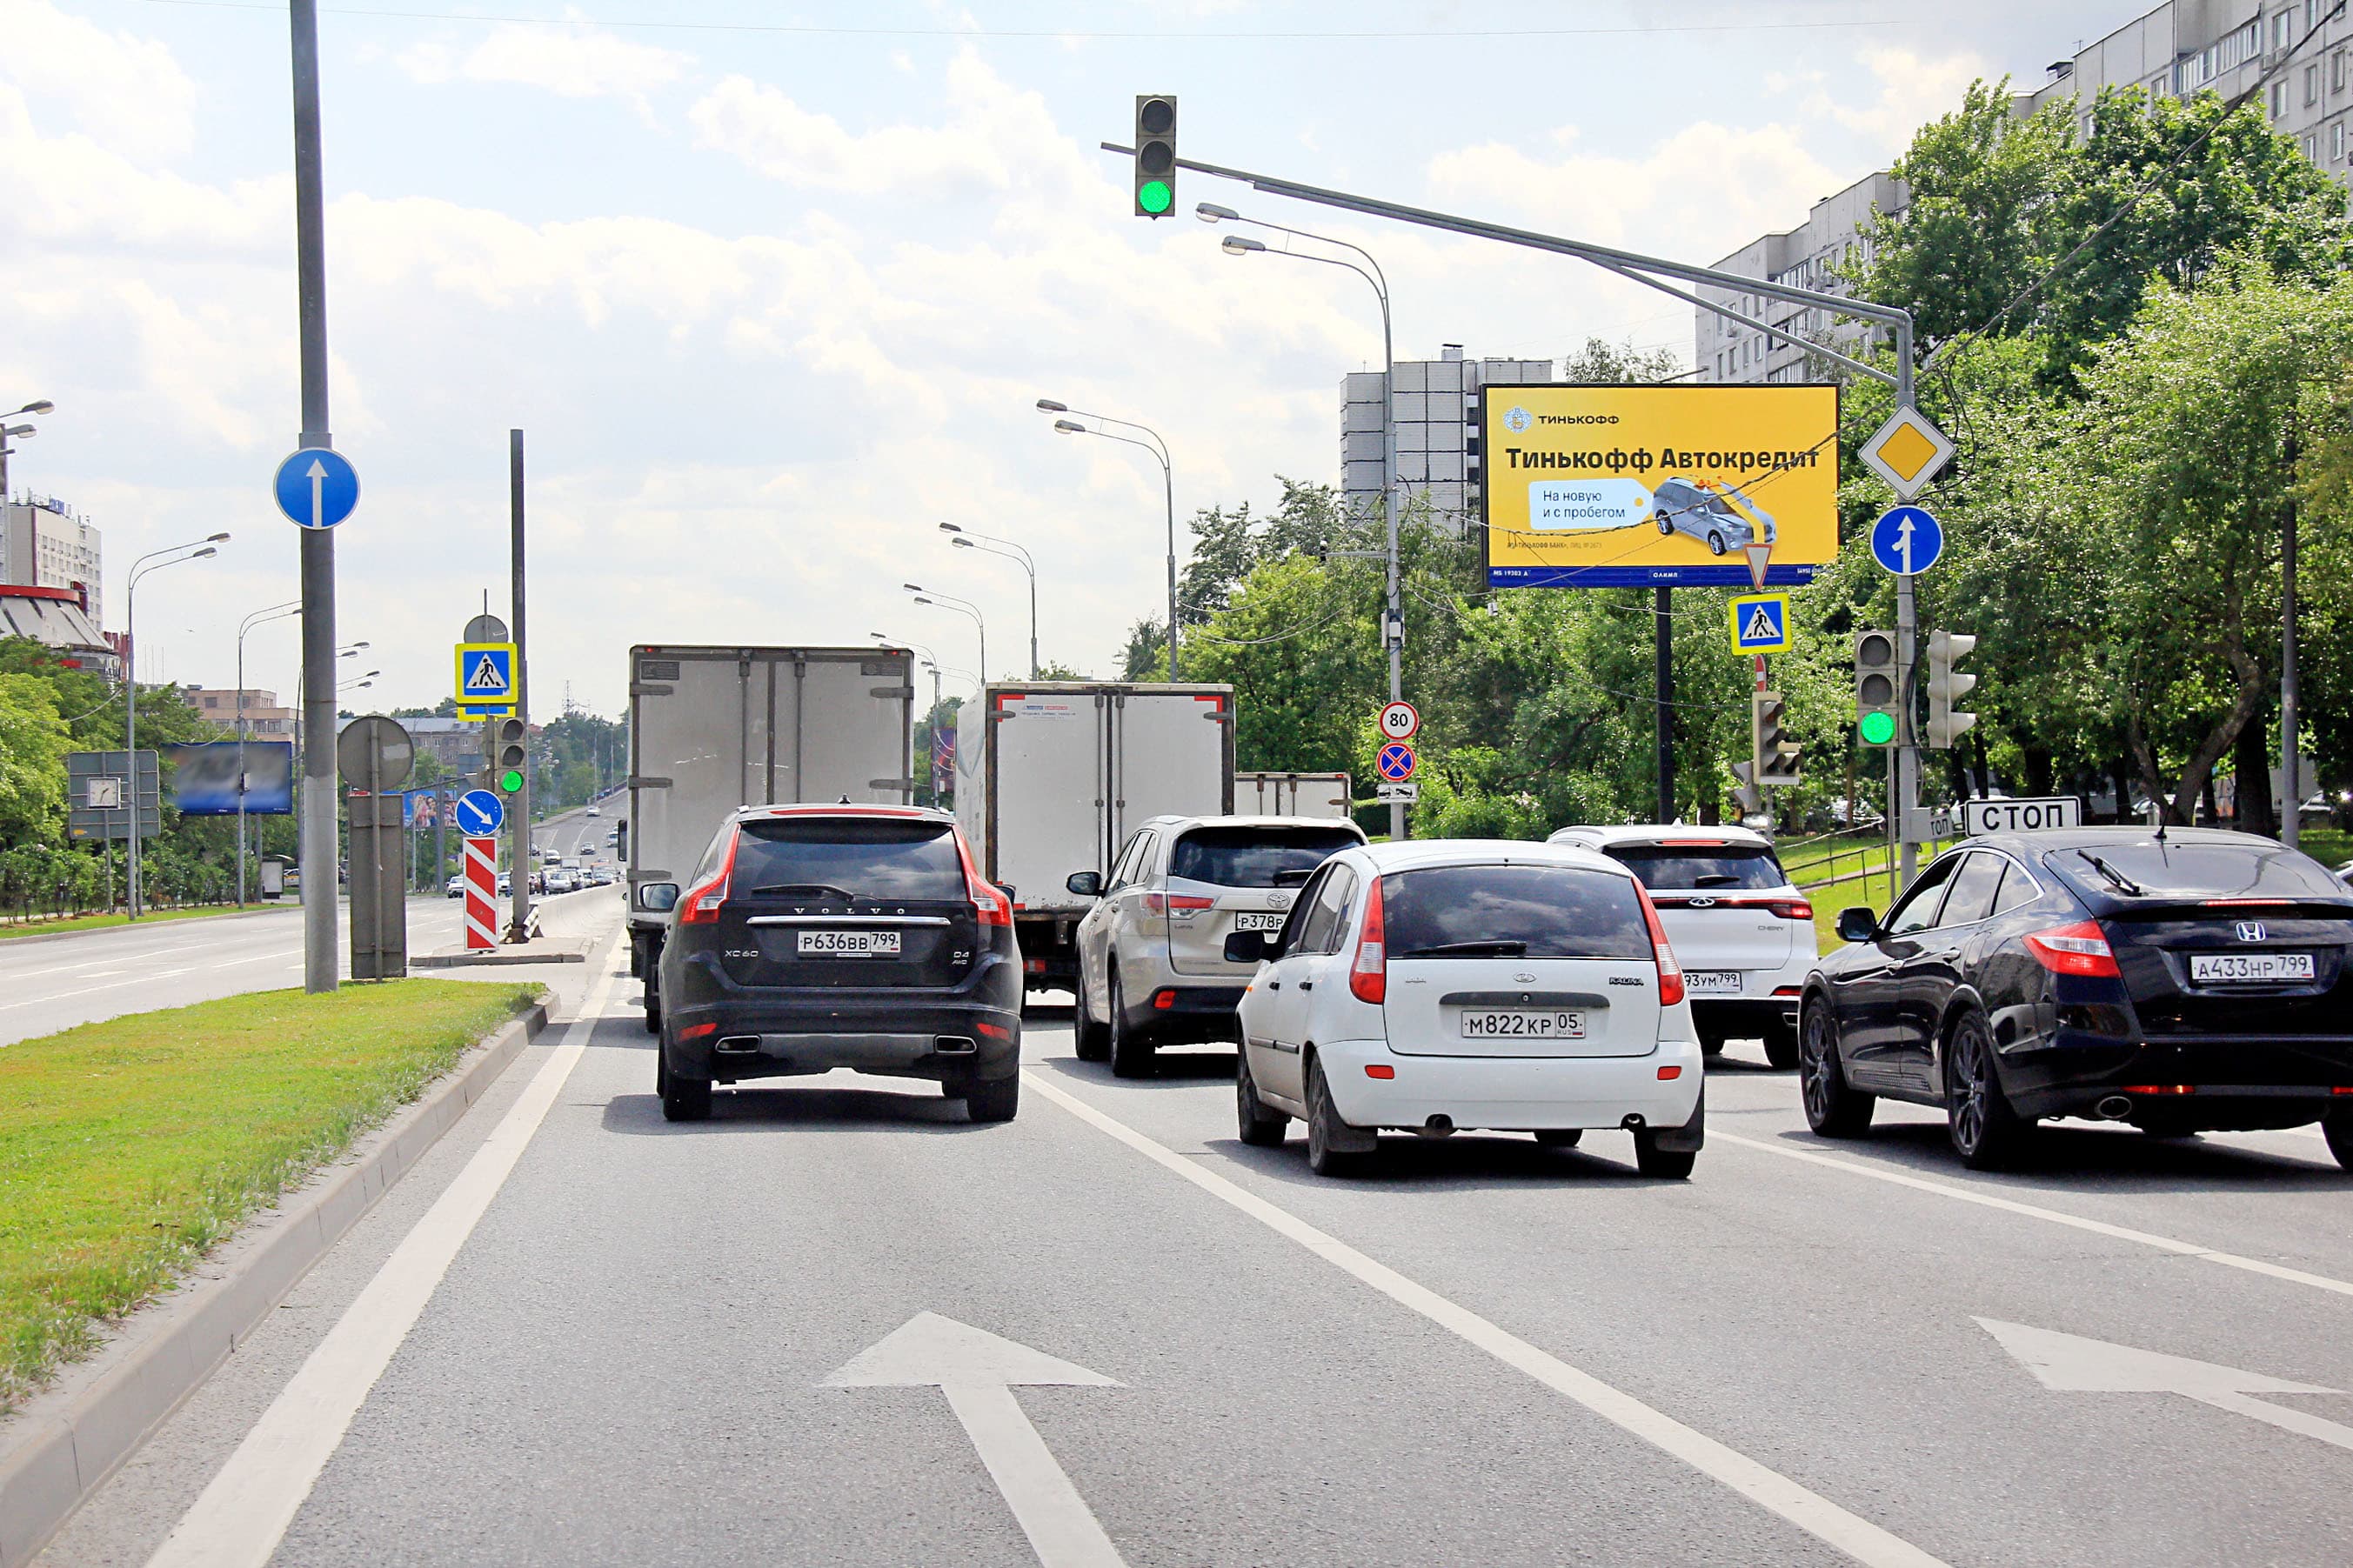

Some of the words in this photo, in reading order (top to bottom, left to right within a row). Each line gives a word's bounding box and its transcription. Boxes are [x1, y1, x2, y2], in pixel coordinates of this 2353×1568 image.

[1538, 416, 1620, 424] ТИНЬКОФФ
[1506, 448, 1654, 474] Тинькофф
[1660, 448, 1820, 473] Автокредит
[1543, 490, 1560, 502] На
[1562, 491, 1602, 504] новую
[1543, 508, 1550, 518] и
[1554, 508, 1561, 518] с
[1564, 505, 1626, 520] пробегом
[1389, 713, 1408, 727] 80
[1982, 804, 2063, 831] СТОП
[1930, 817, 1949, 835] ТОП
[1240, 915, 1284, 928] Р378Р
[872, 933, 896, 945] 799
[2277, 957, 2308, 971] 799
[1608, 977, 1645, 986] KALINA
[1683, 974, 1717, 987] 93УМ
[1558, 1014, 1578, 1029] 05
